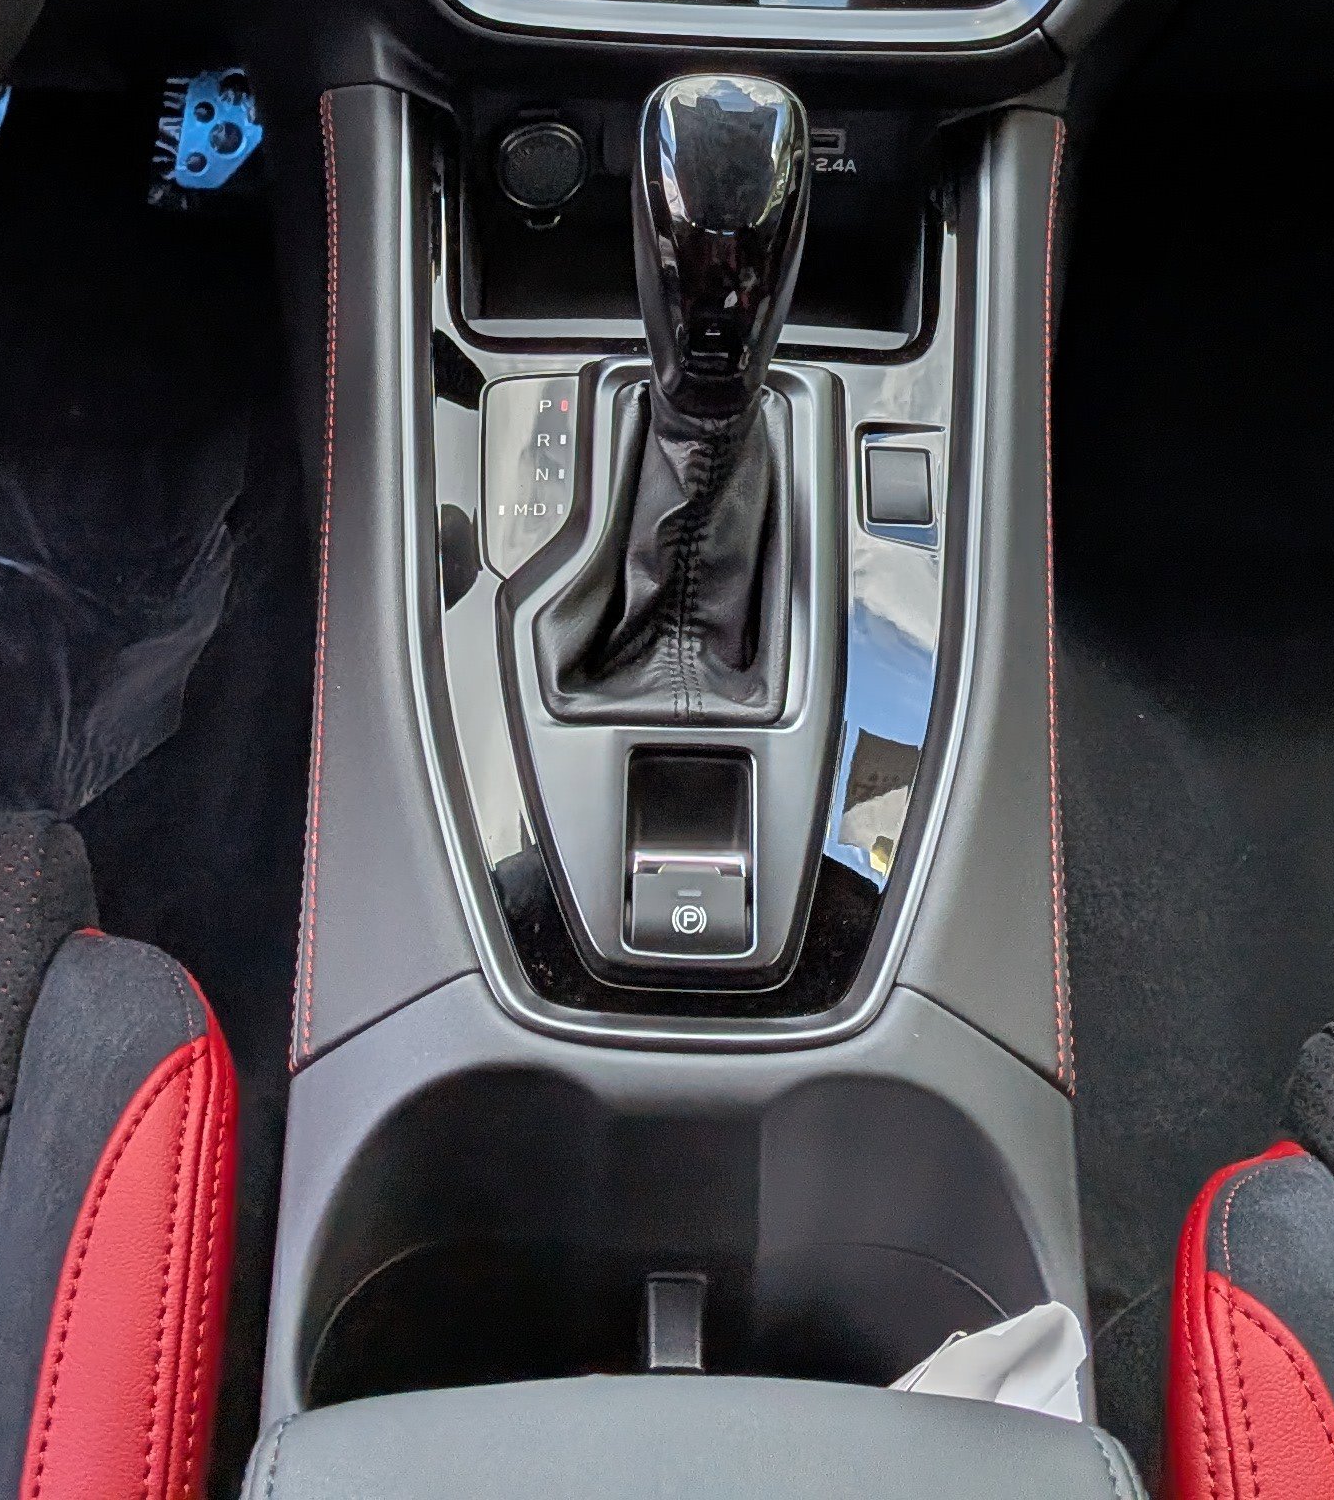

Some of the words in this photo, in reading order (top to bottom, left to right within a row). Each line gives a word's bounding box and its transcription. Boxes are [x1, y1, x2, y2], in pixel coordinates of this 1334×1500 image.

[540, 400, 551, 412] P
[537, 434, 550, 446] R
[536, 469, 548, 480] N
[684, 912, 697, 927] P
